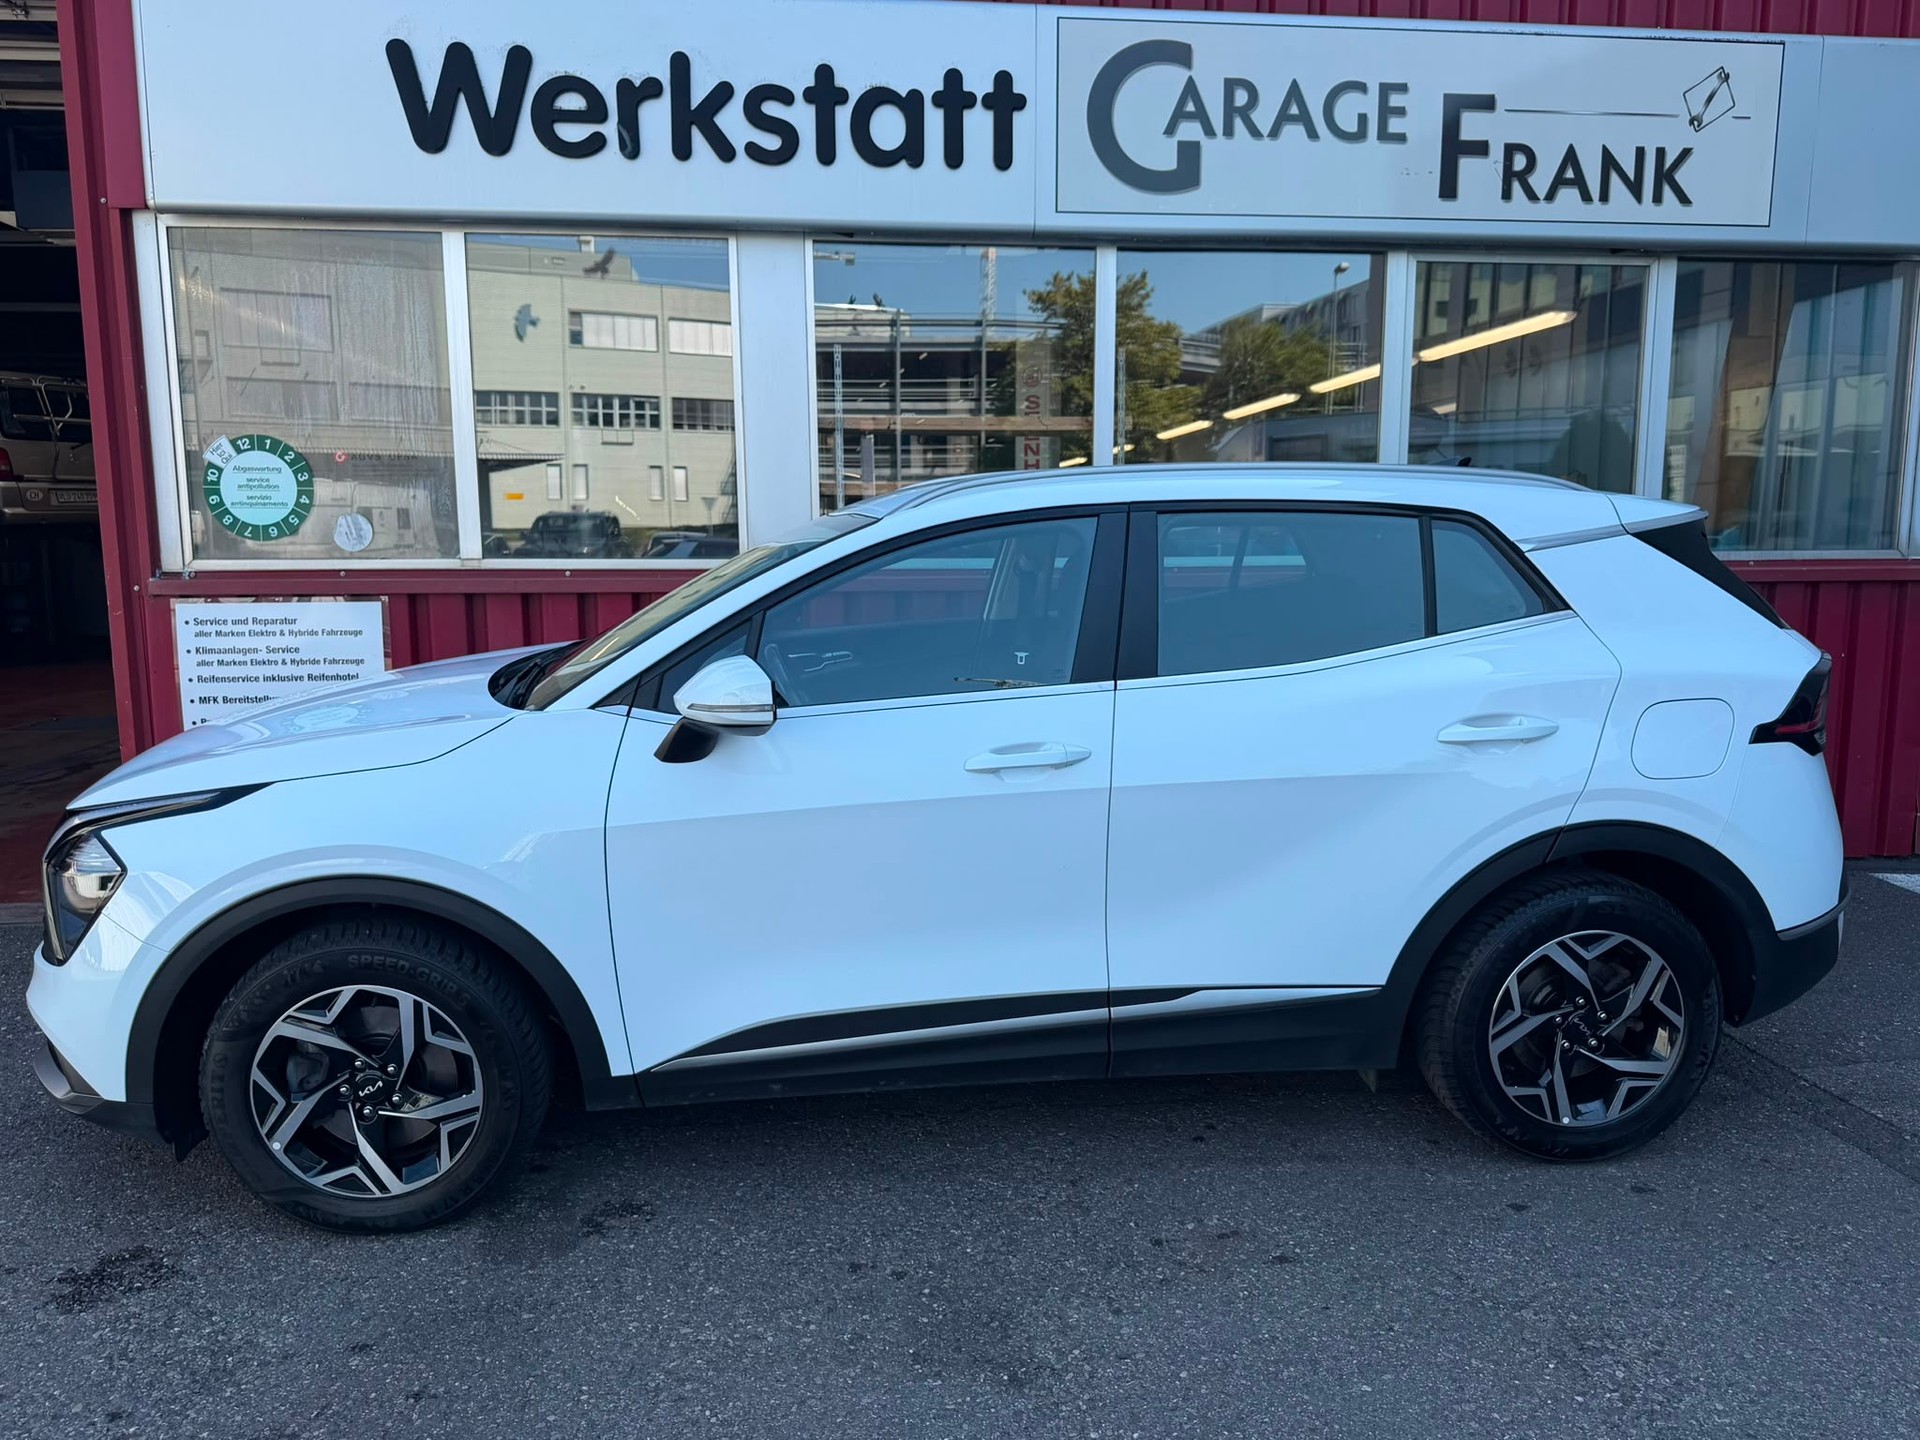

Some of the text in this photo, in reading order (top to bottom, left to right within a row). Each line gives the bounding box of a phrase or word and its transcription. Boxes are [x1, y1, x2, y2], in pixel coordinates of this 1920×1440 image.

[385, 38, 1027, 171] Werkstatt
[1086, 38, 1410, 194] GARAGE
[1438, 92, 1695, 206] FRANK
[236, 438, 251, 450] 12
[264, 439, 272, 450] 1
[284, 451, 295, 462] 2
[232, 465, 282, 474] Abgaswartung
[206, 469, 219, 482] 10
[297, 472, 309, 481] 3
[237, 483, 280, 491] antipollution
[29, 491, 40, 499] CH
[208, 495, 220, 505] 9
[299, 495, 310, 505] 4
[222, 514, 233, 525] 8
[288, 514, 300, 526] 5
[244, 526, 253, 537] 7
[268, 526, 278, 537] 6
[193, 616, 298, 627] Service und Reparatur
[194, 630, 212, 638] aller
[248, 629, 277, 637] Elektro
[279, 629, 286, 637] &
[288, 629, 319, 638] Hybride
[321, 628, 363, 638] Fahrzeuge
[195, 645, 300, 656] Klimaanlagen- Service
[196, 659, 214, 667] aller
[250, 658, 279, 666] Elektro
[281, 658, 287, 666] &
[290, 658, 321, 667] Hybride
[323, 657, 365, 667] Fahrzeuge
[197, 672, 359, 684] Reifenservice inklusive Reifenhotel
[198, 696, 220, 704] MFK
[347, 954, 458, 991] SPEED-GRIP
